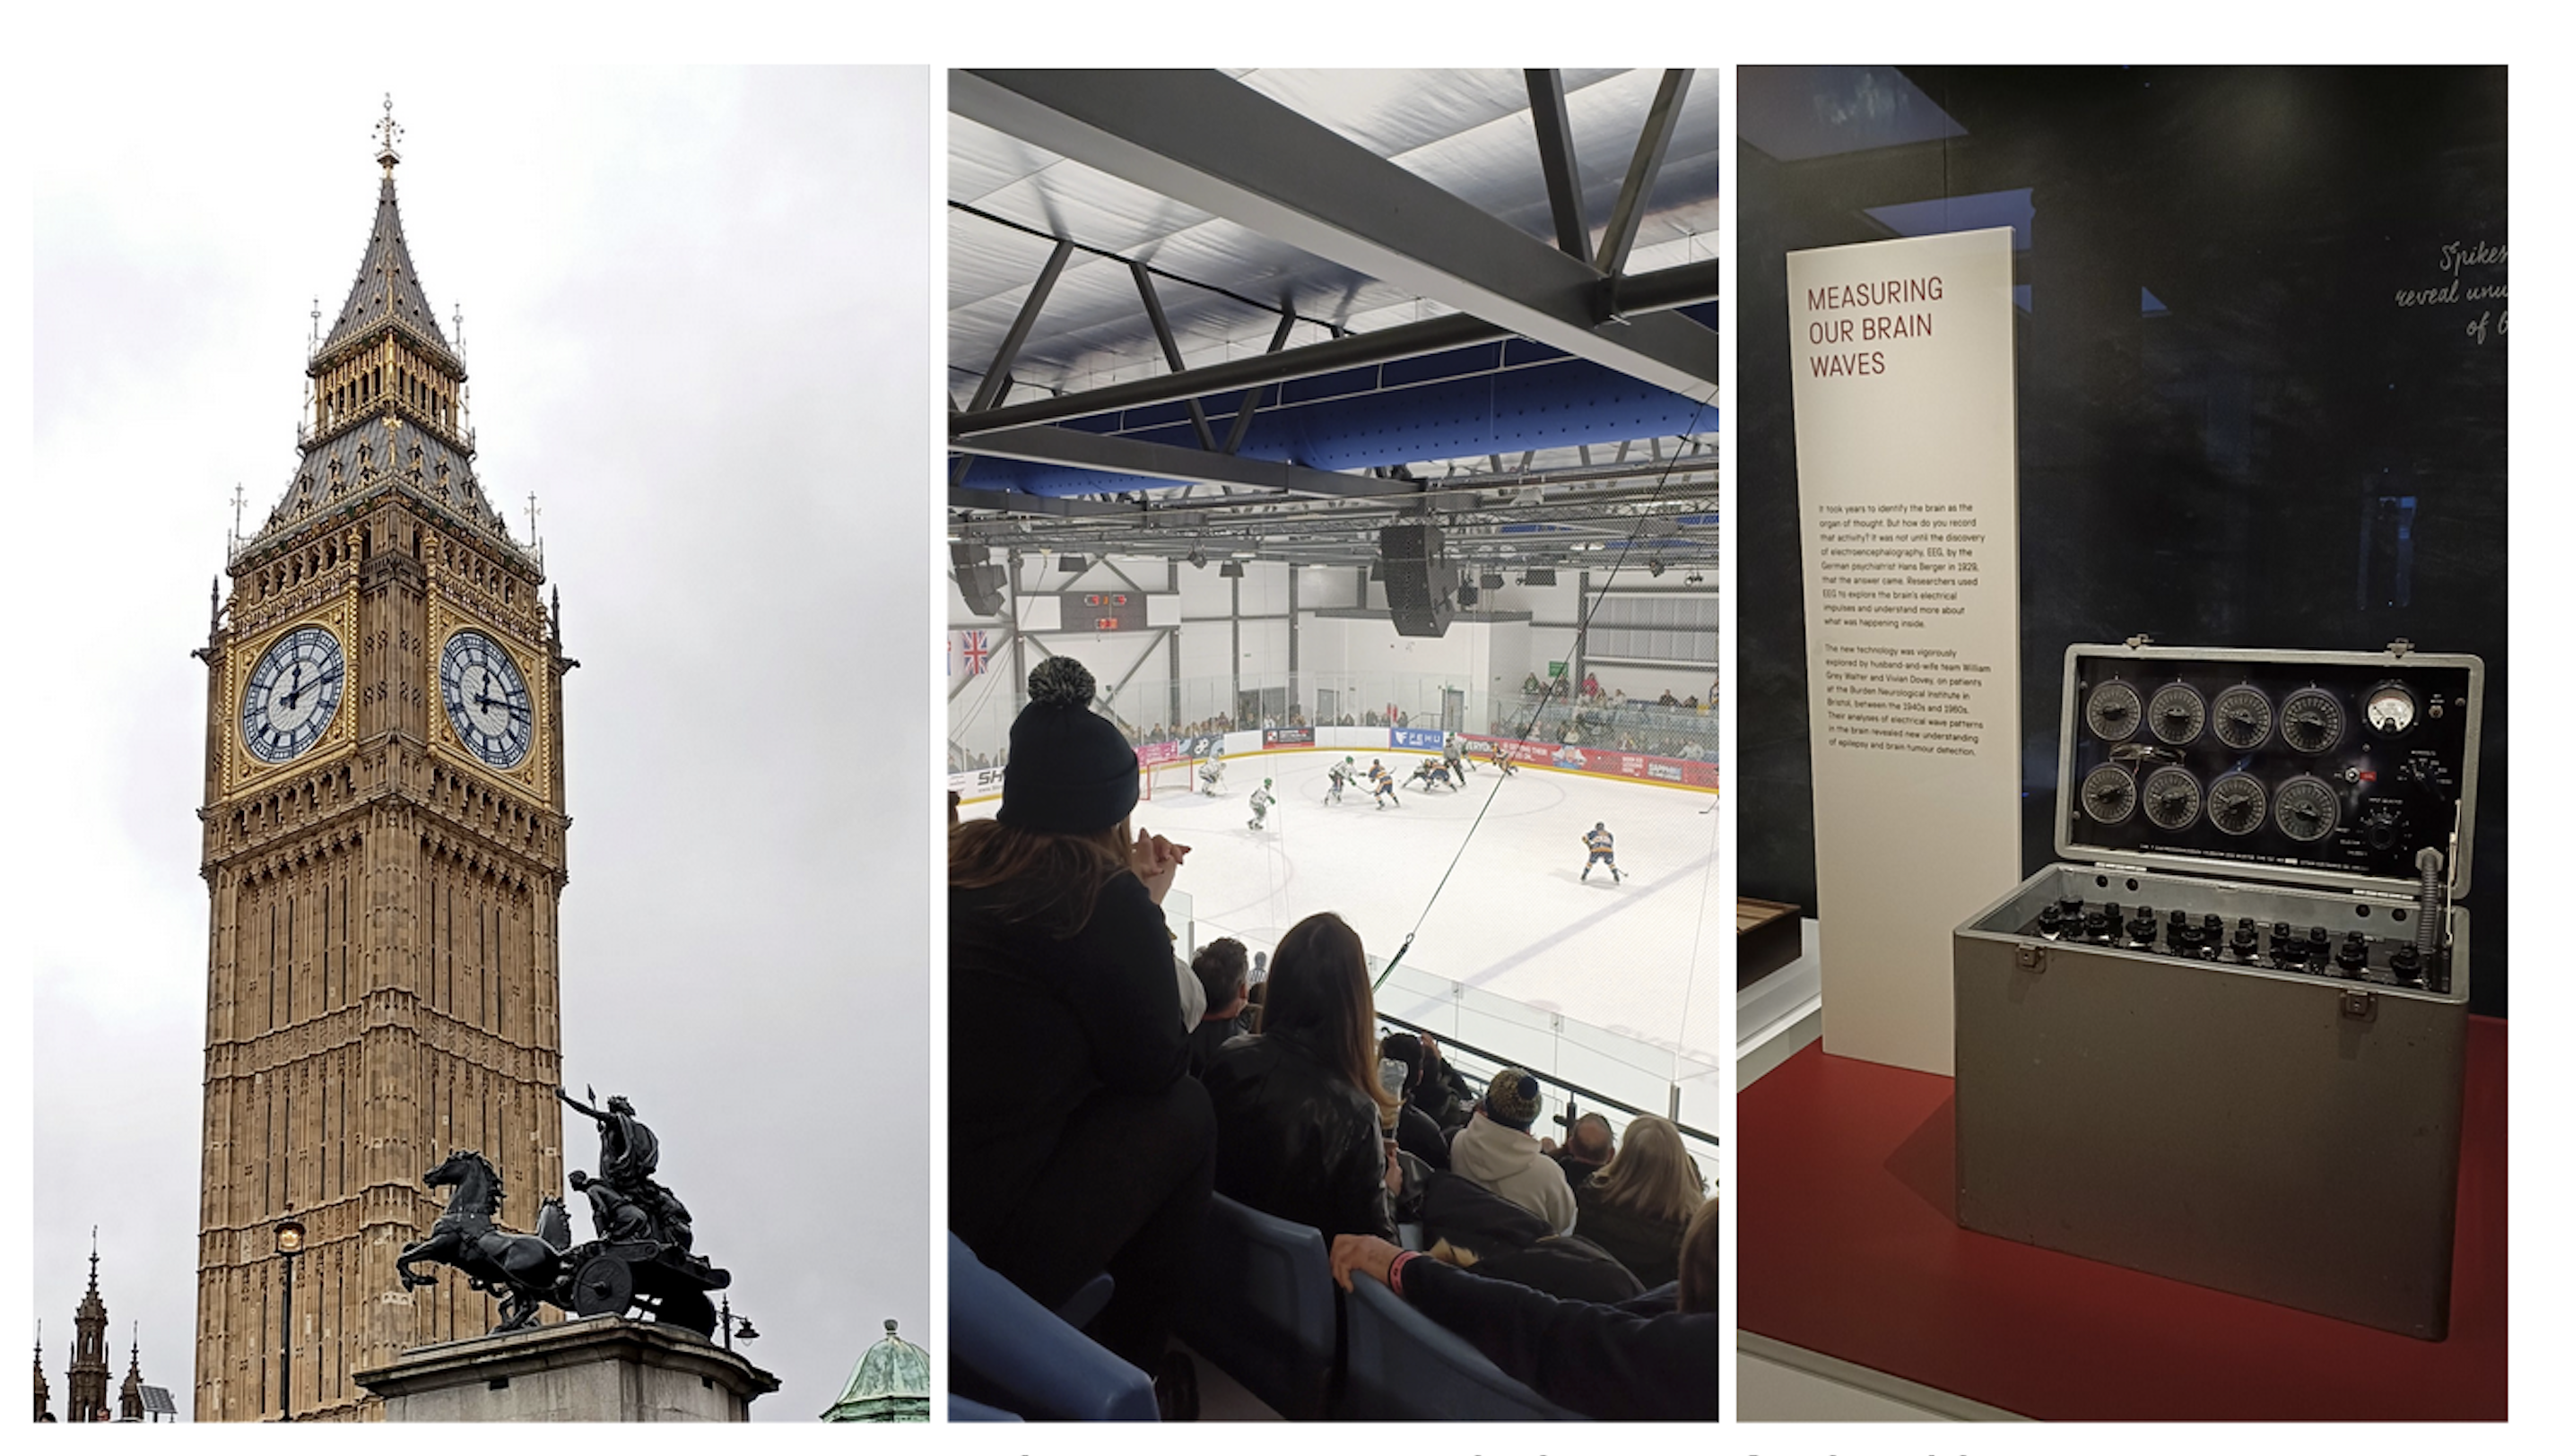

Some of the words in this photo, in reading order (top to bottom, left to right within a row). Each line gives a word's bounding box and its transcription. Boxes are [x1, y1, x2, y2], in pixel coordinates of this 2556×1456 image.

[1807, 276, 1943, 311] MEASURING
[2395, 279, 2459, 307] reveal
[1809, 319, 1854, 344] OUR
[1863, 313, 1933, 341] BRAIN
[2465, 310, 2491, 345] of
[1810, 351, 1886, 378] WAVES
[1826, 505, 1843, 513] took
[1844, 506, 1865, 514] years
[1877, 504, 1908, 513] identify
[1909, 504, 1923, 512] the
[1925, 504, 1945, 512] brain
[1947, 504, 1957, 512] as
[1959, 503, 1973, 511] the
[1819, 520, 1841, 529] organ
[1841, 518, 1851, 527] of
[1886, 517, 1900, 527] But
[1901, 518, 1917, 527] how
[1919, 518, 1931, 527] do
[1932, 519, 1947, 528] you
[1949, 518, 1976, 526] record
[1819, 533, 1835, 542] that
[1894, 533, 1908, 542] not
[1909, 533, 1928, 542] until
[1930, 533, 1943, 542] the
[1945, 533, 1986, 542] discovery
[1820, 547, 1829, 556] of
[1946, 548, 1957, 558] by
[1959, 548, 1972, 557] the
[1821, 560, 1849, 570] German
[1851, 562, 1896, 571] psychiatrist
[1918, 561, 1946, 573] Berger
[1821, 576, 1837, 584] that
[1838, 576, 1851, 584] the
[1906, 576, 1955, 585] Researchers
[1957, 577, 1978, 585] used
[1821, 588, 1837, 598] EEG
[1847, 591, 1876, 599] explore
[1877, 590, 1891, 599] the
[1919, 591, 1957, 600] electrical
[1857, 604, 1873, 612] and
[1874, 605, 1917, 613] understand
[1942, 606, 1964, 614] about
[1823, 617, 1841, 625] what
[1858, 619, 1899, 628] happening
[1824, 643, 1838, 652] The
[1856, 646, 1899, 656] technology
[1916, 648, 1957, 658] vigorously
[1825, 659, 1857, 667] explored
[1858, 659, 1868, 668] by
[1940, 663, 1960, 672] team
[1825, 670, 1842, 680] Grey
[1844, 672, 1867, 680] Walter
[1869, 673, 1883, 681] and
[1936, 677, 1948, 685] on
[1949, 678, 1982, 687] patients
[1836, 685, 1847, 693] the
[1849, 685, 1876, 694] Burden
[1877, 687, 1925, 698] Neurological
[1926, 690, 1960, 699] Institute
[1854, 699, 1887, 708] between
[1888, 701, 1900, 710] the
[1927, 704, 1942, 713] and
[1827, 710, 1846, 719] Their
[1847, 714, 1879, 722] analyses
[1880, 715, 1889, 723] of
[1891, 715, 1926, 724] electrical
[1949, 720, 1983, 728] patterns
[1836, 725, 1849, 733] the
[1850, 726, 1870, 734] brain
[1871, 728, 1903, 737] revealed
[1922, 732, 1978, 743] understanding
[1828, 737, 1837, 745] of
[1838, 740, 1868, 748] epilepsy
[1870, 741, 1883, 750] and
[1906, 743, 1934, 752] tumour
